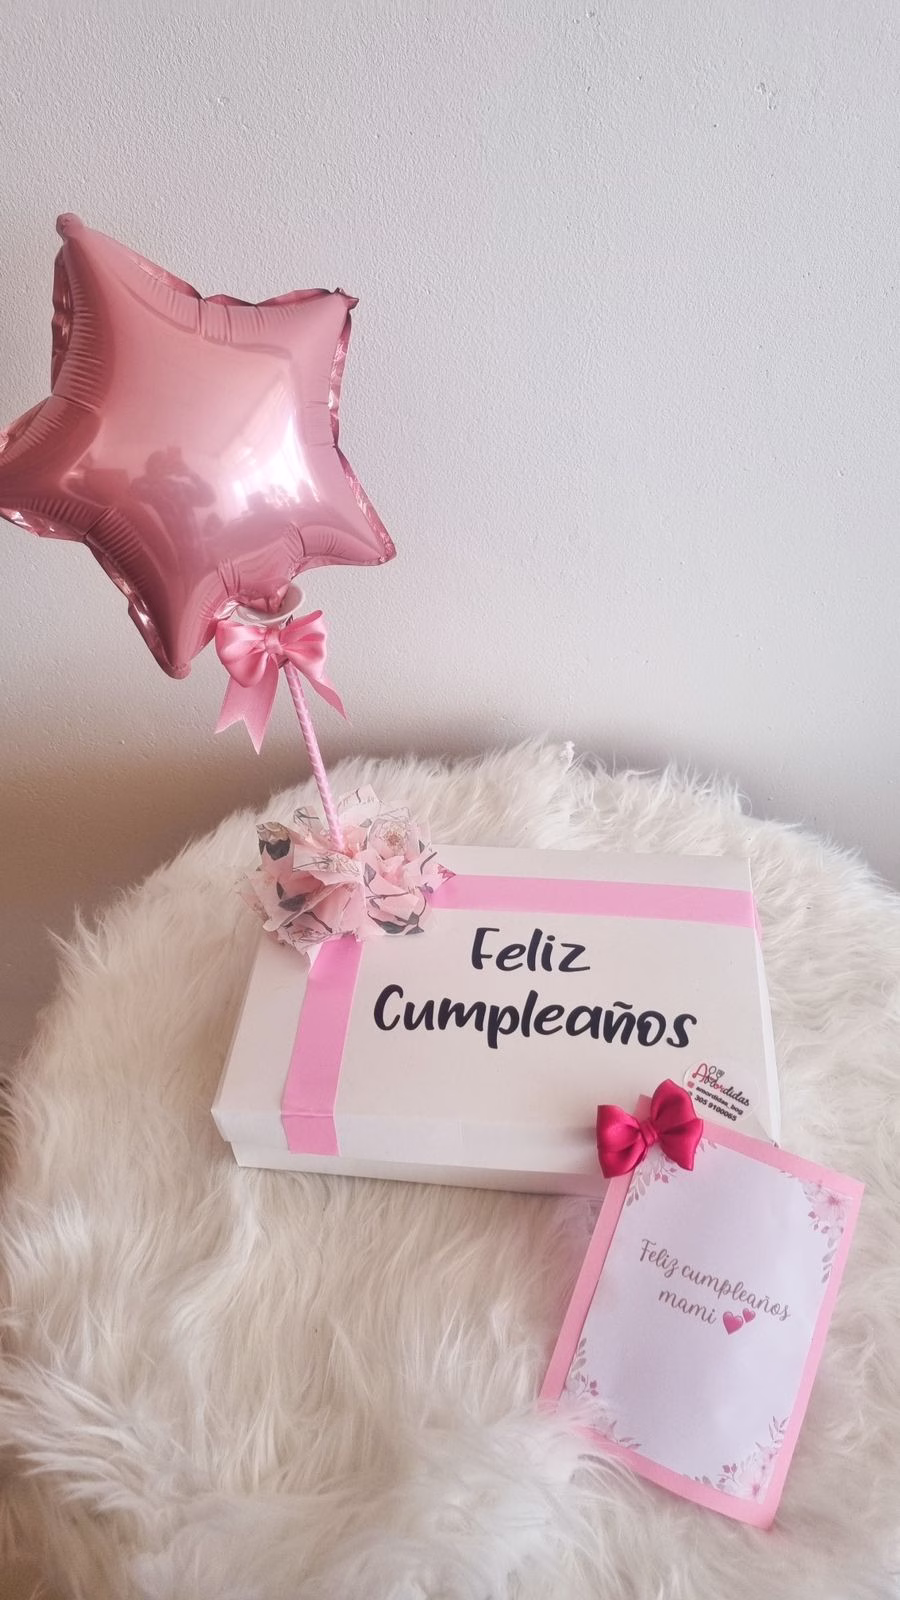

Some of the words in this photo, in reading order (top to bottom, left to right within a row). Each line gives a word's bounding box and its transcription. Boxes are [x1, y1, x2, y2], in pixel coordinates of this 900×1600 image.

[471, 927, 591, 972] Feliz
[373, 984, 697, 1049] Cumpleaños
[694, 1094, 707, 1105] 305
[639, 1238, 679, 1278] Feliz
[681, 1265, 791, 1321] cumpleaños
[658, 1290, 717, 1324] mami
